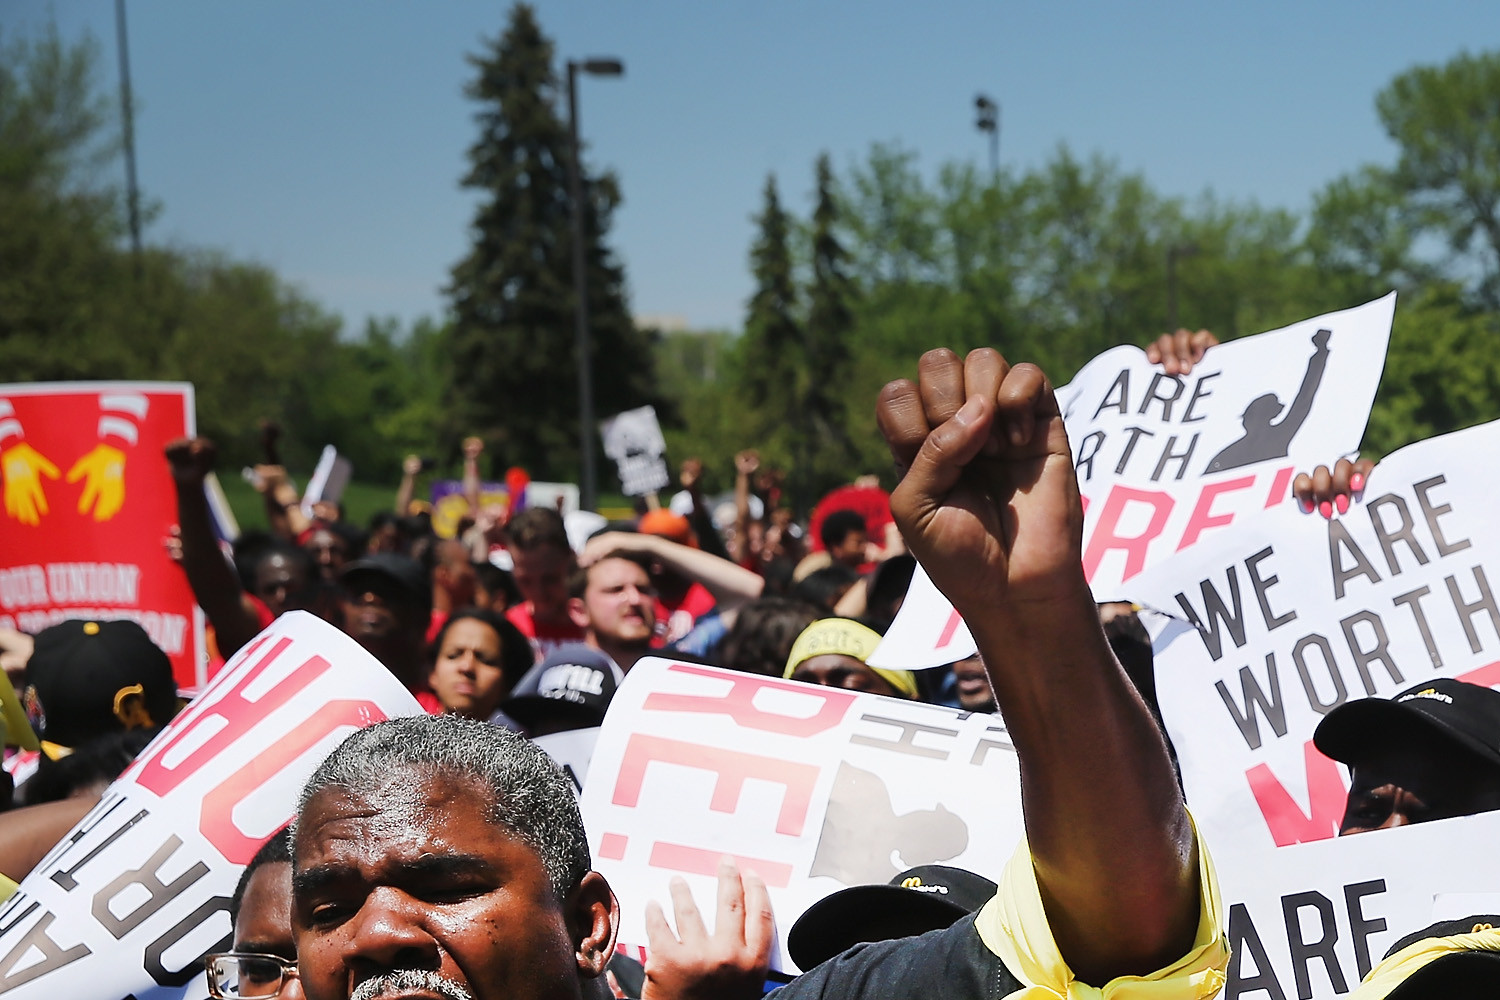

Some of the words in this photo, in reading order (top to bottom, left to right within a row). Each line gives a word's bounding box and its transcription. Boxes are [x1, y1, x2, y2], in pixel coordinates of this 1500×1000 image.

[1092, 368, 1222, 423] ARE
[1075, 427, 1201, 481] RTH
[46, 562, 139, 604] UNION
[1175, 545, 1297, 662] WE
[1328, 474, 1471, 599] ARE
